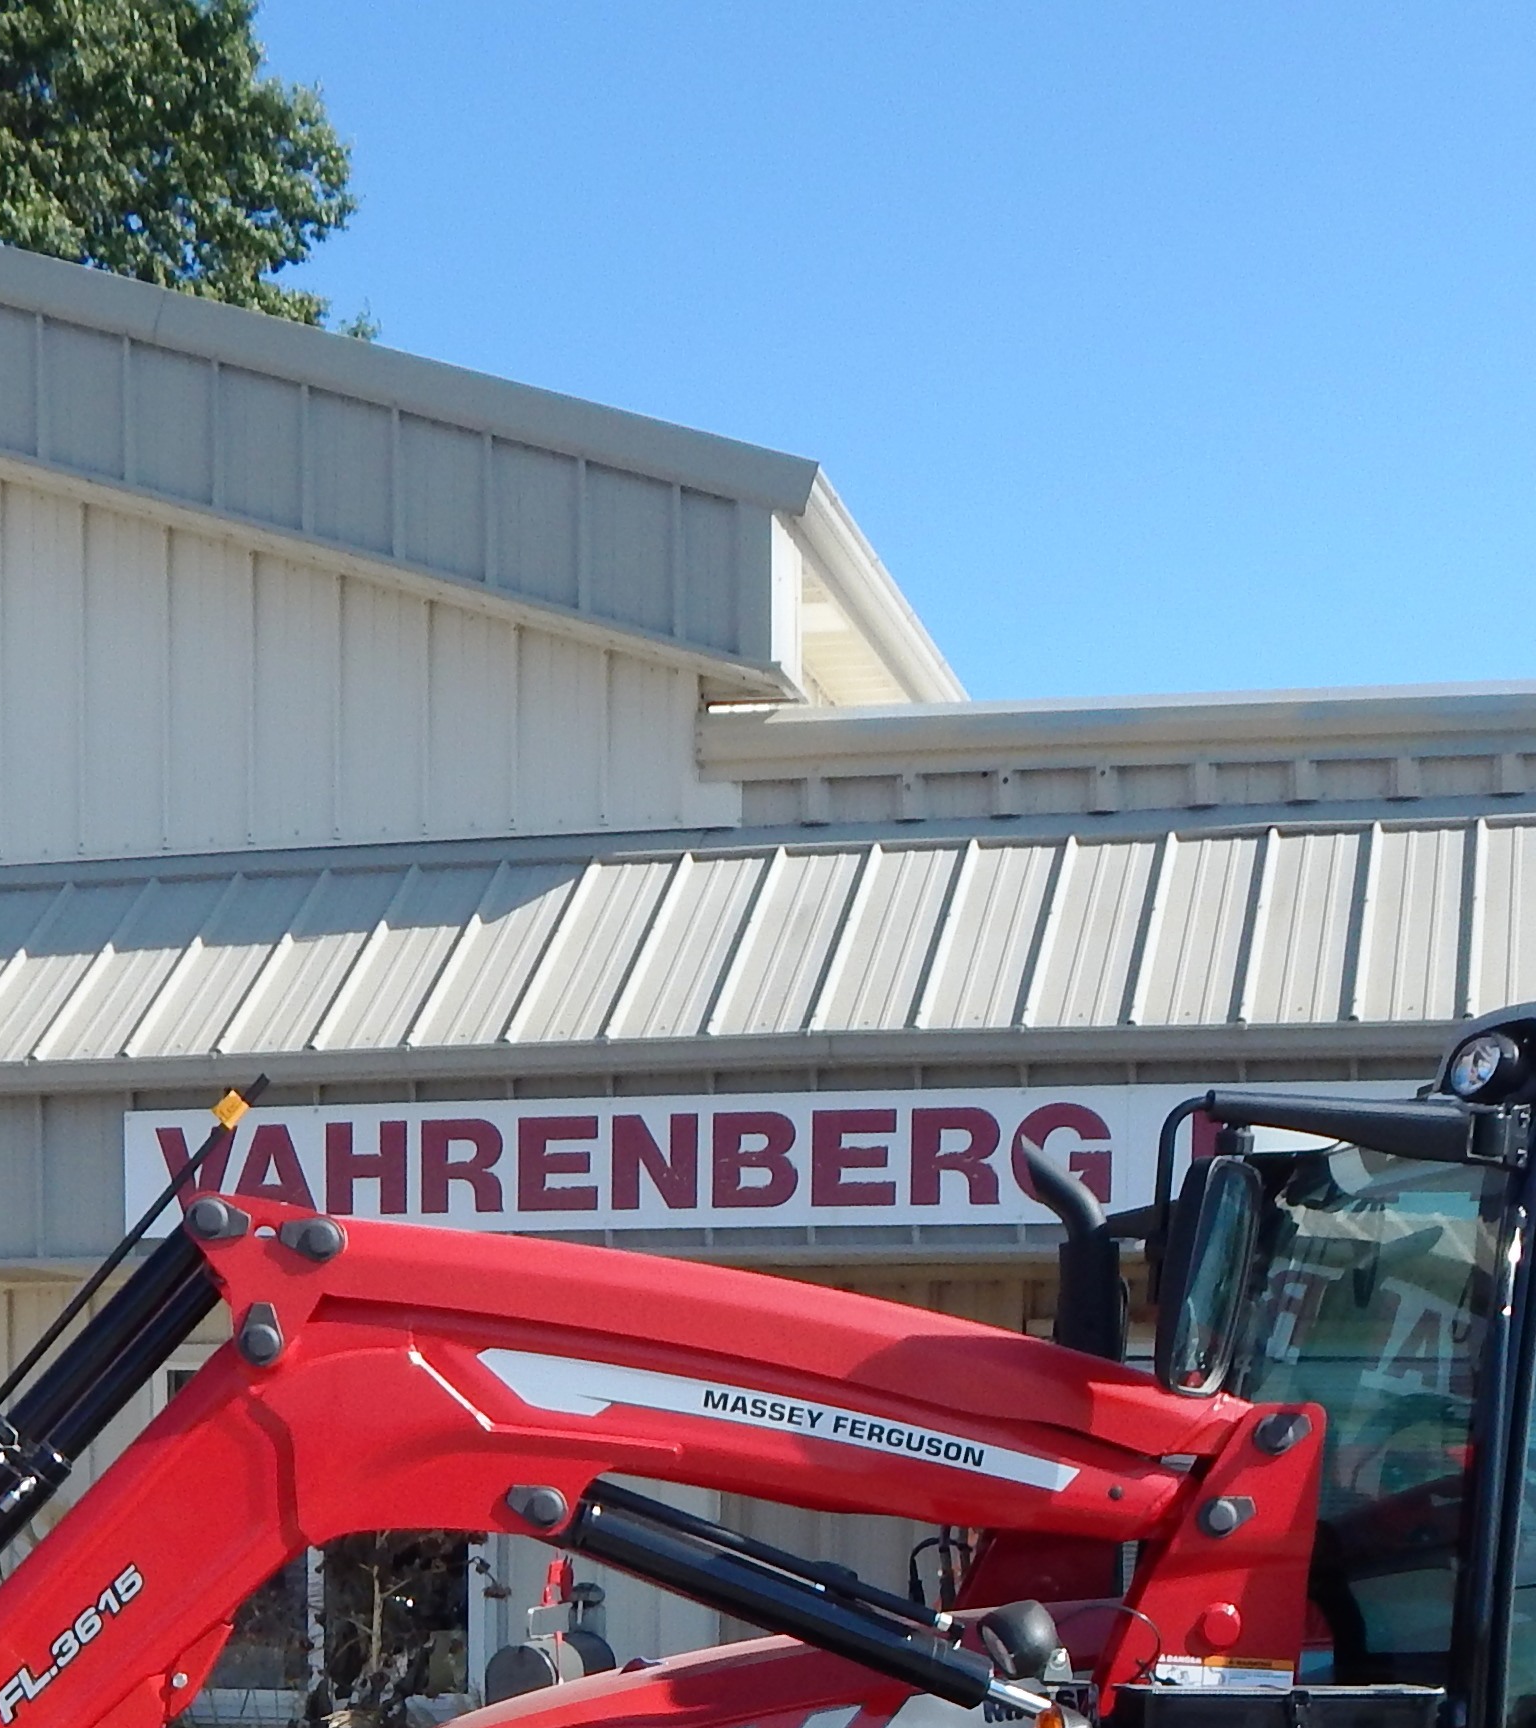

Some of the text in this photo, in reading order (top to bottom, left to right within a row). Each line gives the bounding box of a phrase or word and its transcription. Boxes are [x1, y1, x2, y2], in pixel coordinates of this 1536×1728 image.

[156, 1102, 1112, 1216] VAHRENBERG
[703, 1390, 985, 1467] MASSEY FERGUSON
